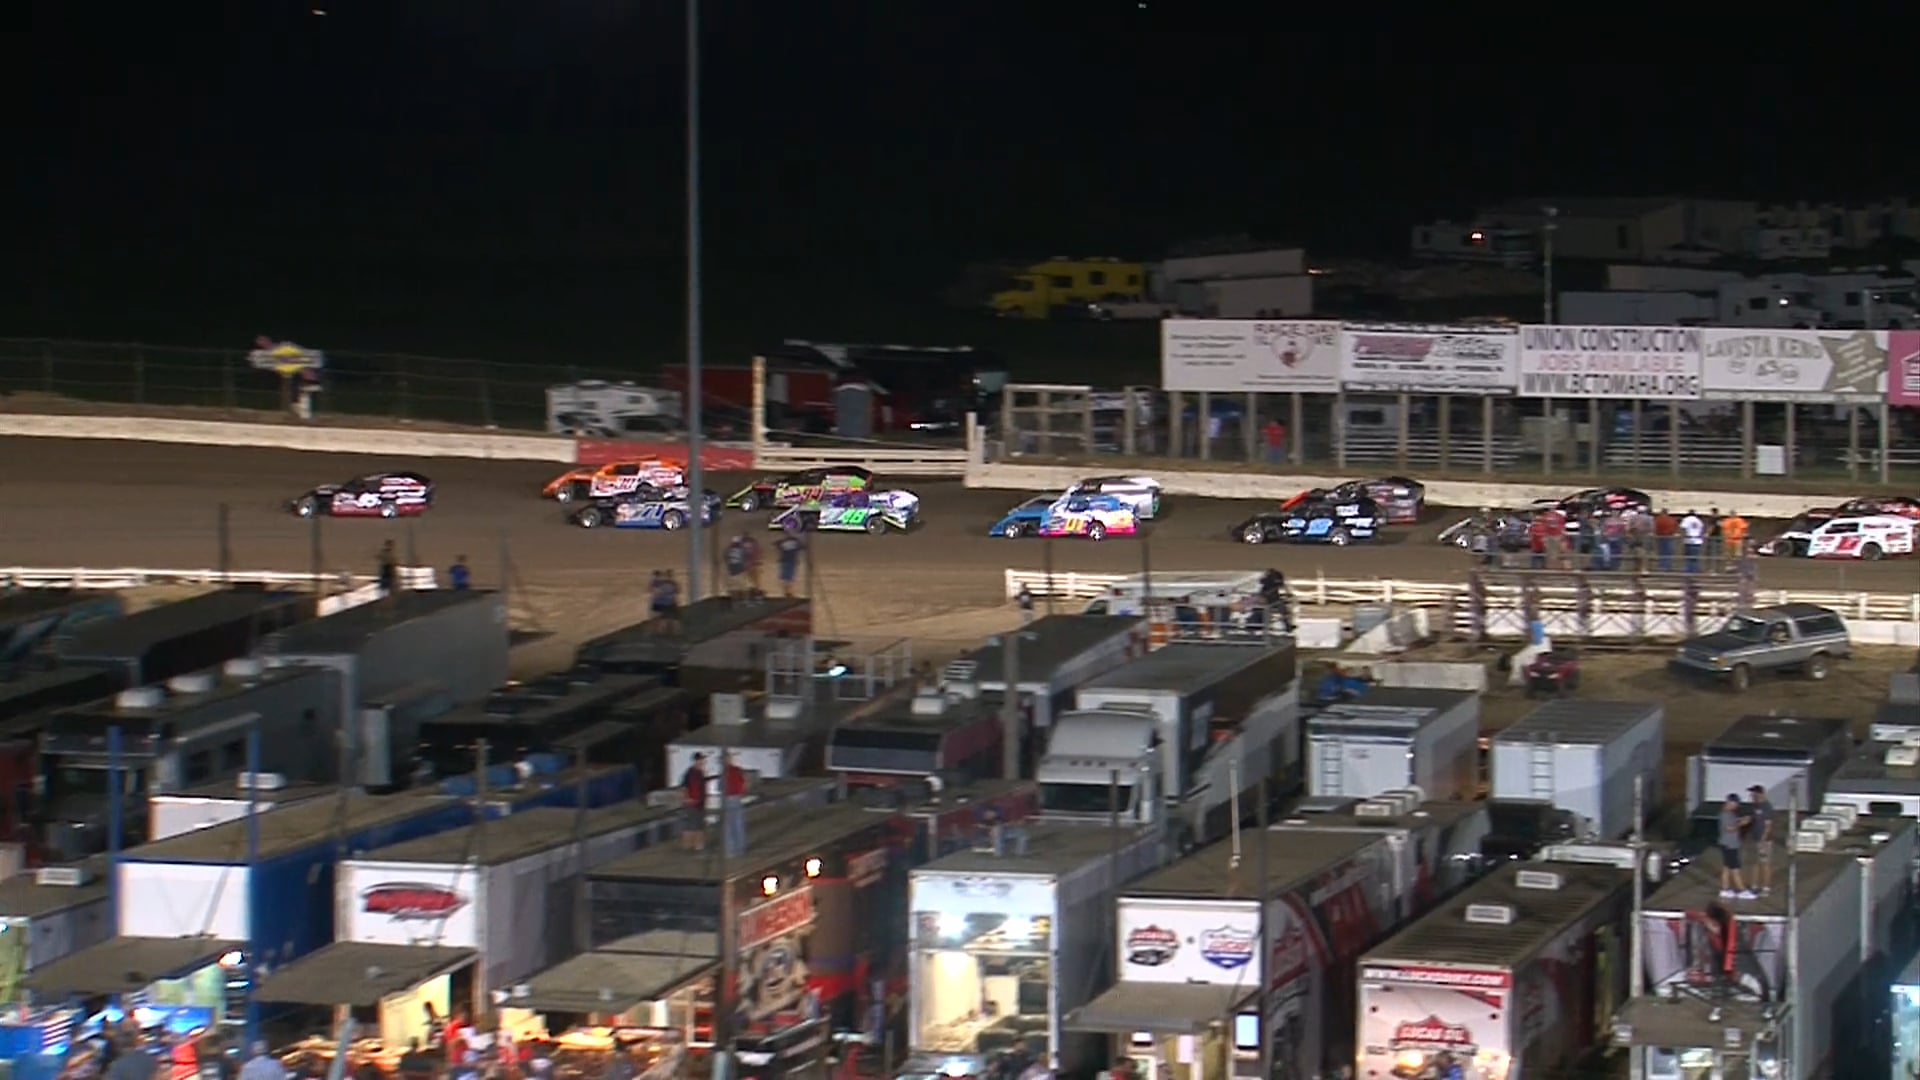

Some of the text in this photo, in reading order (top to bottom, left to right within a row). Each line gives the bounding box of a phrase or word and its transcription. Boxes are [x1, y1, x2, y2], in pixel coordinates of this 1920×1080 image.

[1523, 327, 1575, 350] UNION
[1579, 328, 1700, 353] CONSTRUCTION
[1537, 354, 1685, 373] JOBS AVAILABLE
[1523, 373, 1700, 396] WWW.BCTOMAHA.ORG
